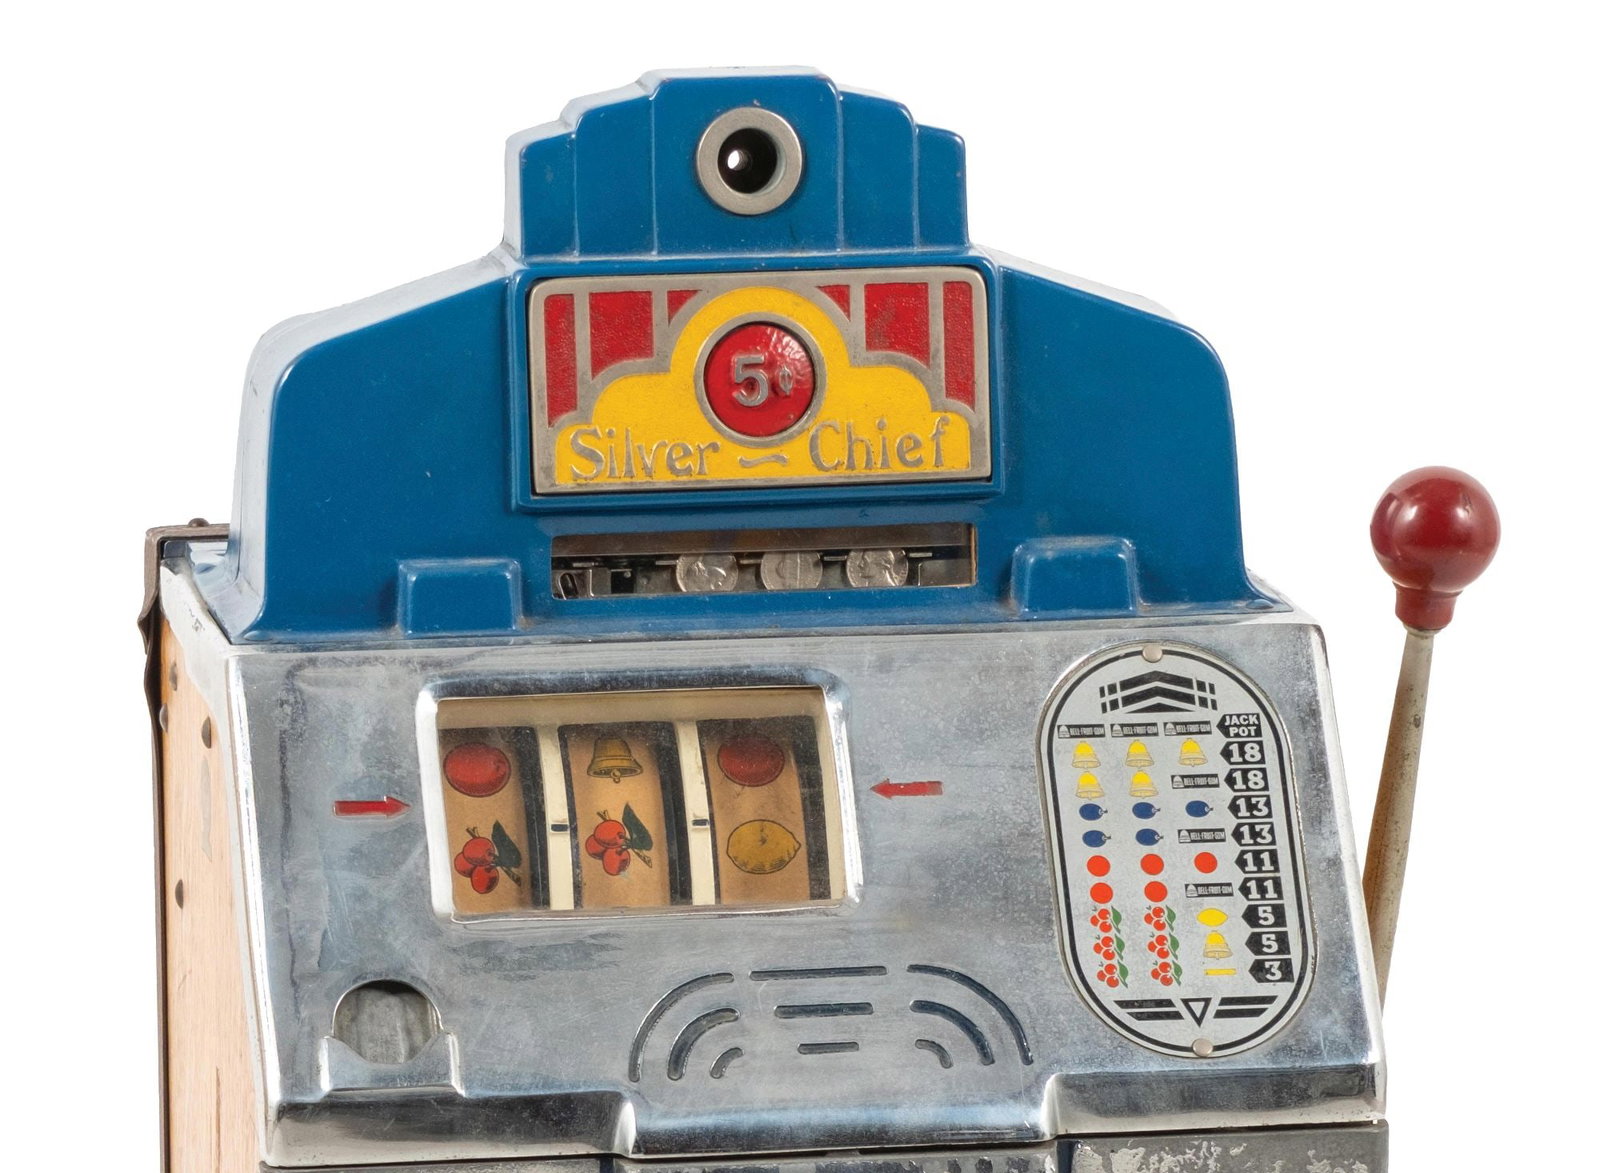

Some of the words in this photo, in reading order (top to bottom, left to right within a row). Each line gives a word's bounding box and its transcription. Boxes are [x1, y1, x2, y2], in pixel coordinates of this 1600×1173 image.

[570, 424, 720, 481] Silver
[809, 416, 951, 473] Chief
[1224, 714, 1259, 726] JACK
[1229, 726, 1257, 737] POT
[1229, 742, 1262, 763] 18
[1232, 770, 1265, 790] 18
[1236, 797, 1269, 817] 13
[1240, 824, 1273, 844] 13
[1243, 851, 1275, 872] 11
[1246, 879, 1278, 899] 11
[1257, 905, 1275, 926] 5
[1261, 933, 1279, 953] 5
[1264, 961, 1282, 981] 3
